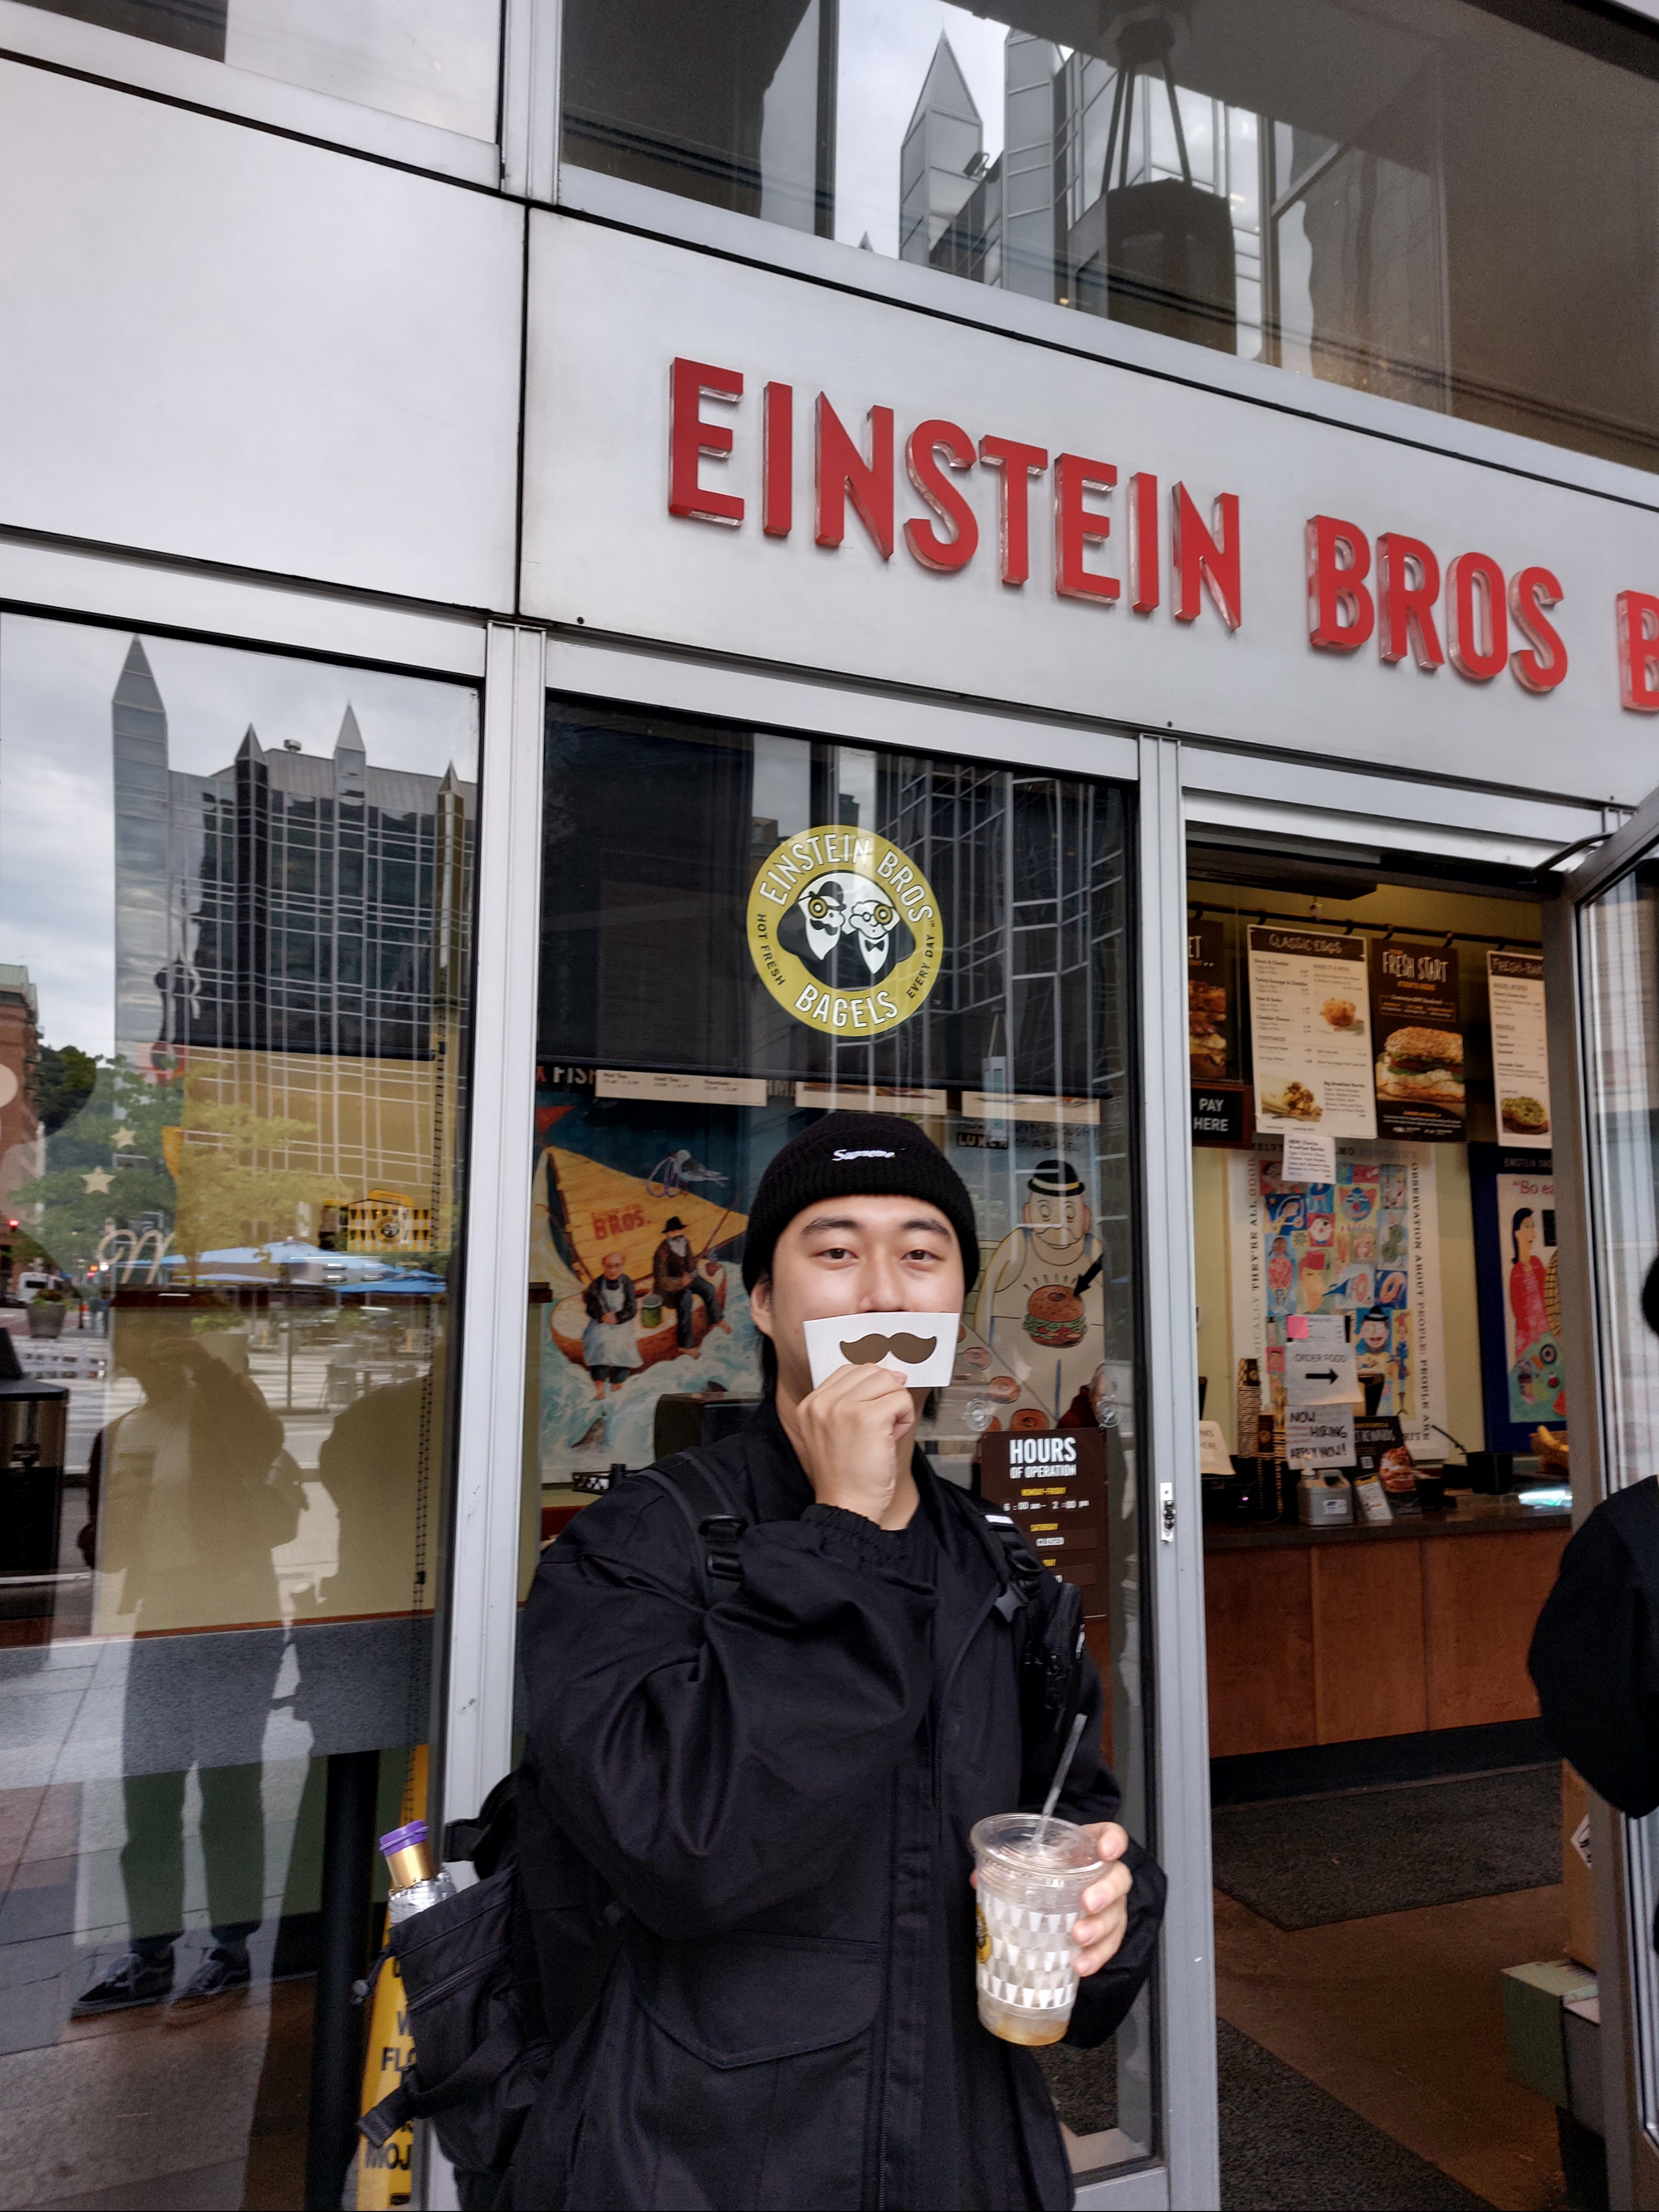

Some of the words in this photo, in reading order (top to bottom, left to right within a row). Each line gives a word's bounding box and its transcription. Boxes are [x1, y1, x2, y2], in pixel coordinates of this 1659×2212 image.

[669, 357, 1241, 631] EINSTEIN
[1306, 514, 1568, 692] BROS
[759, 833, 871, 906] EINSTEIN
[876, 850, 934, 923] BROS
[757, 913, 767, 940] HOT
[761, 946, 786, 986] FRESH
[907, 962, 930, 999] EVERY
[926, 934, 935, 958] DAY
[1382, 951, 1415, 979] FRESH
[1417, 956, 1449, 983] START
[794, 983, 898, 1029] BAGELS
[1199, 1098, 1224, 1112] PAY
[1193, 1117, 1229, 1132] HERE
[1249, 1198, 1258, 1226] ALL
[1411, 1162, 1423, 1249] OBSERVATION
[1415, 1255, 1425, 1298] ABOUT
[1294, 1354, 1322, 1363] ORDER
[1323, 1354, 1347, 1363] FOOD
[1421, 1359, 1430, 1409] PEOPLE
[1289, 1411, 1316, 1423] NOW
[1422, 1415, 1431, 1441] ARE
[1309, 1425, 1348, 1438] HIRING
[1009, 1436, 1077, 1464] HOURS
[1010, 1467, 1024, 1479] OF
[1024, 1464, 1077, 1479] OPERATION
[381, 2047, 416, 2071] FLO
[363, 2141, 411, 2170] MOJ
